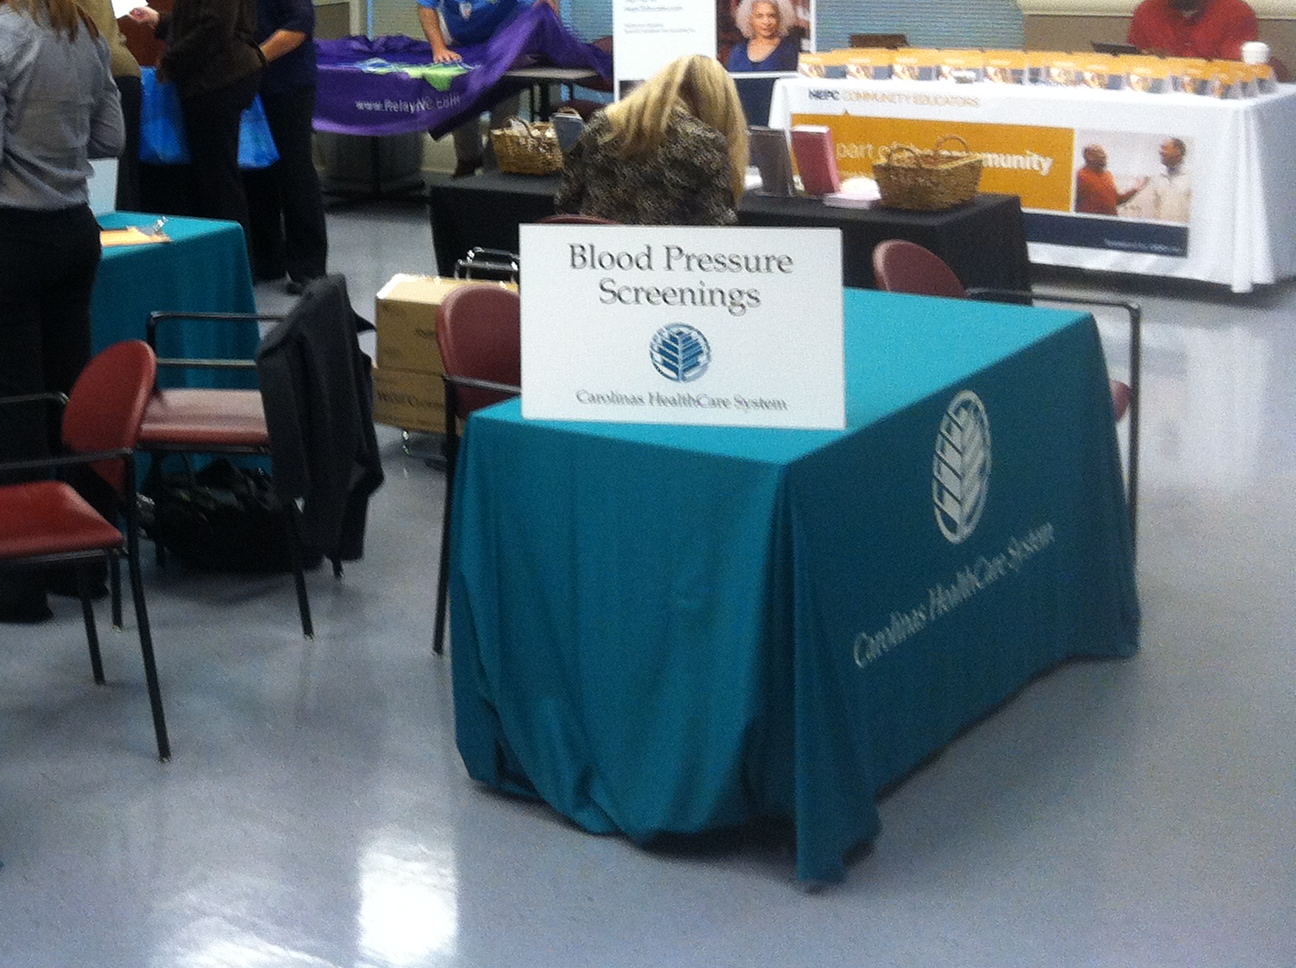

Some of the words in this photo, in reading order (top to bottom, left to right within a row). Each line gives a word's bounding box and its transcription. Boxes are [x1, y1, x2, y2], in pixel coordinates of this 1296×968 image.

[842, 90, 912, 105] COMMUNITY
[966, 149, 1054, 176] munity
[567, 242, 655, 272] Blood
[663, 244, 794, 274] Pressure
[598, 277, 761, 317] Screenings
[575, 388, 645, 408] Carolinas
[648, 391, 731, 410] HealthCare
[733, 393, 790, 413] System
[853, 602, 928, 669] Carolinas
[926, 552, 1007, 622] HealthCare
[1006, 521, 1056, 573] System
